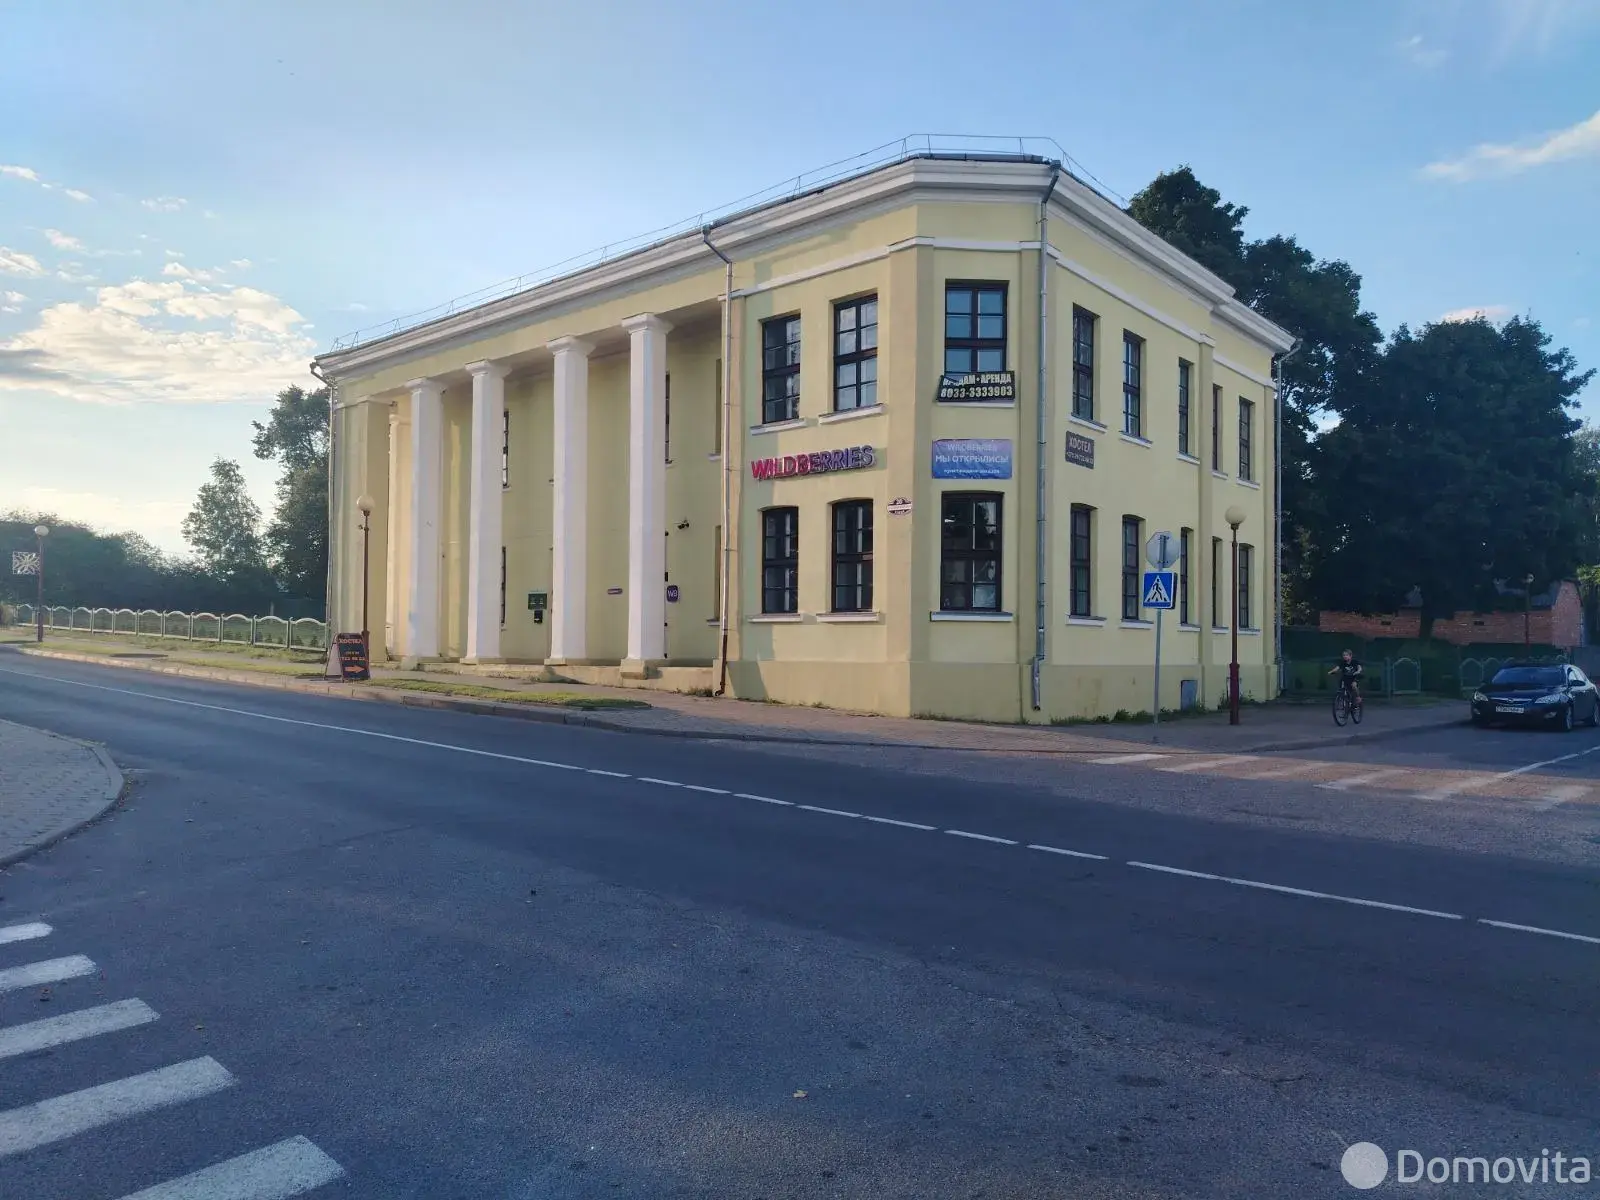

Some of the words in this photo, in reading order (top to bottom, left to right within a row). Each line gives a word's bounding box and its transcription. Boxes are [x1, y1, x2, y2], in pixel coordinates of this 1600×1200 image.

[980, 374, 1012, 385] АРЕНДА
[941, 386, 1012, 398] 8033-3333903
[1070, 436, 1092, 454] ХОСТЕЛ
[751, 445, 873, 479] WILDBERRIES
[935, 454, 951, 463] МЫ
